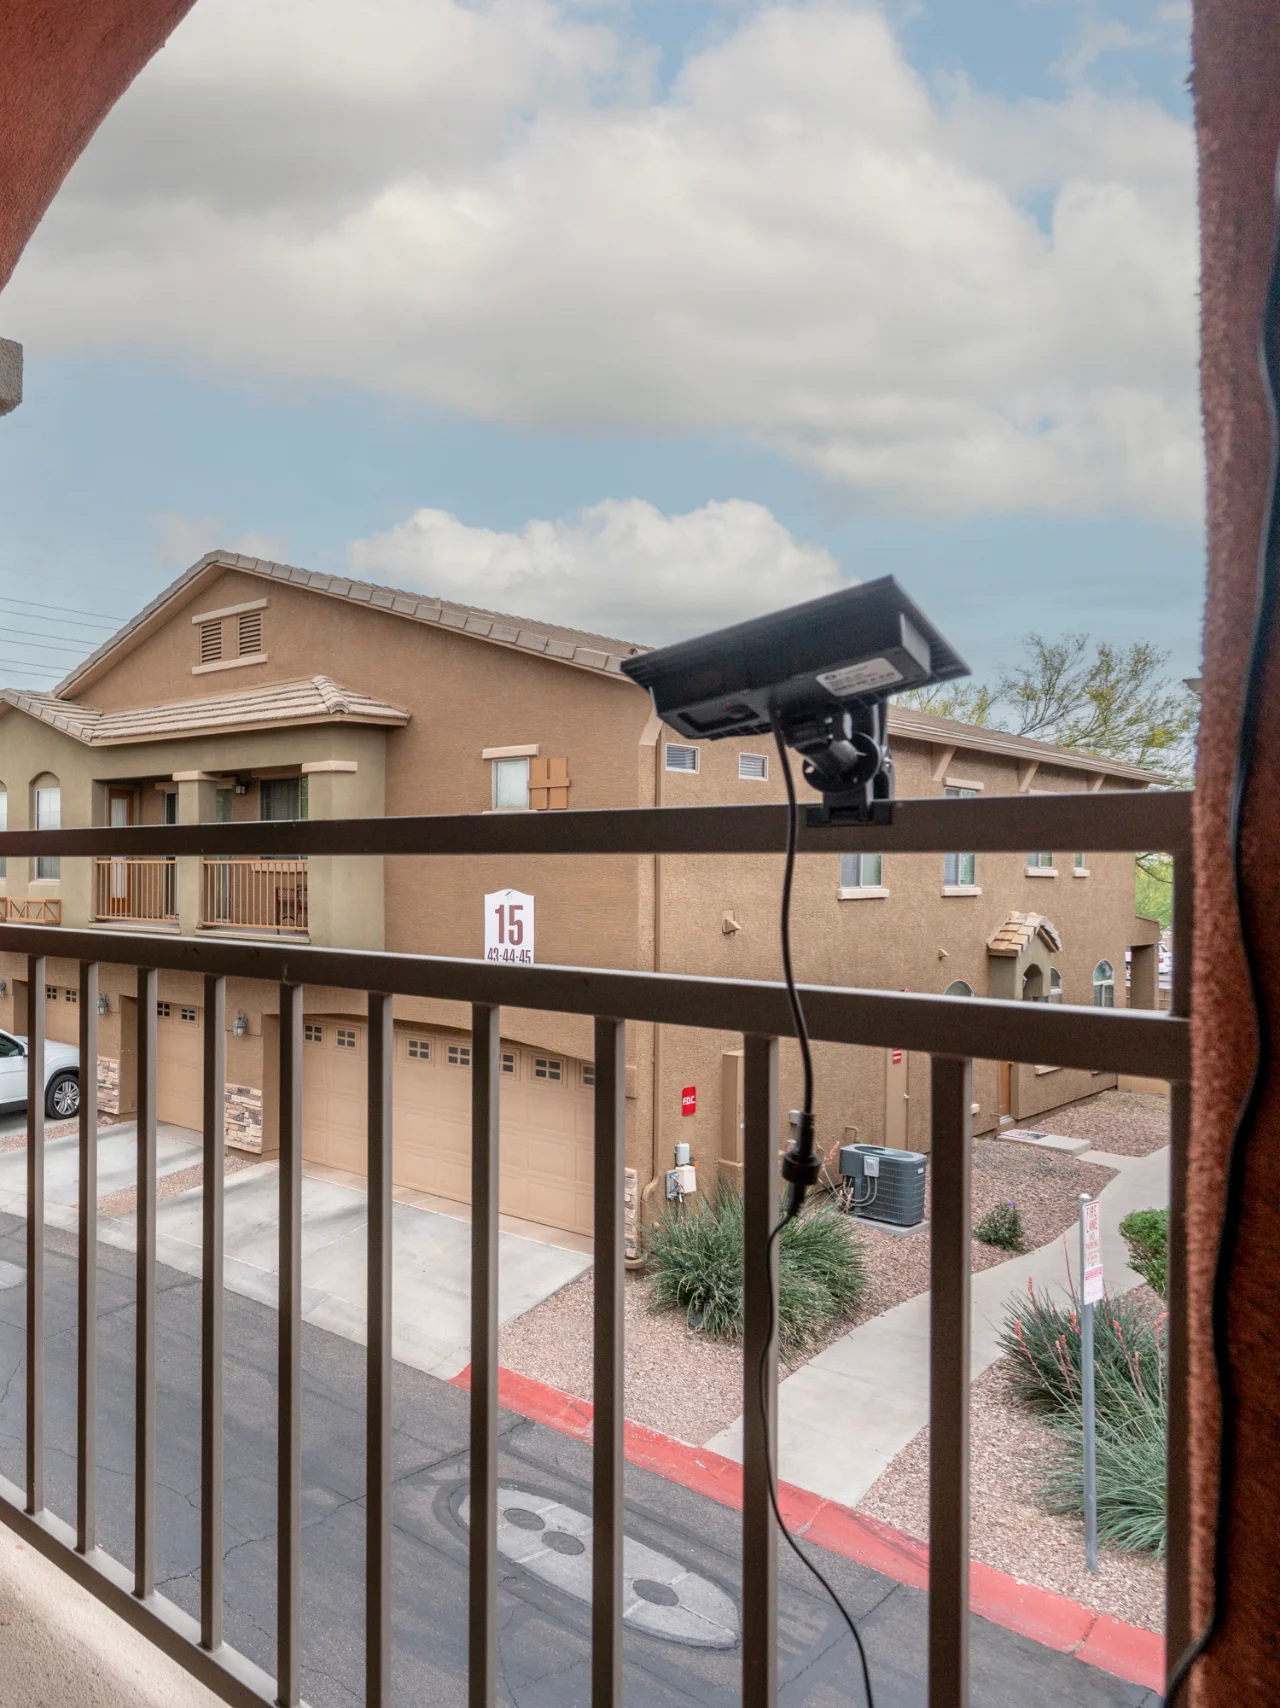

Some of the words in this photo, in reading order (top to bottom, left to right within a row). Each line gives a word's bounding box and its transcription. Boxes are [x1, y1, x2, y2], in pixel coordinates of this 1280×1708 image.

[495, 904, 524, 945] 15
[487, 947, 532, 964] 43-44-45
[1085, 1204, 1098, 1219] FIRE
[1085, 1218, 1098, 1233] LANE
